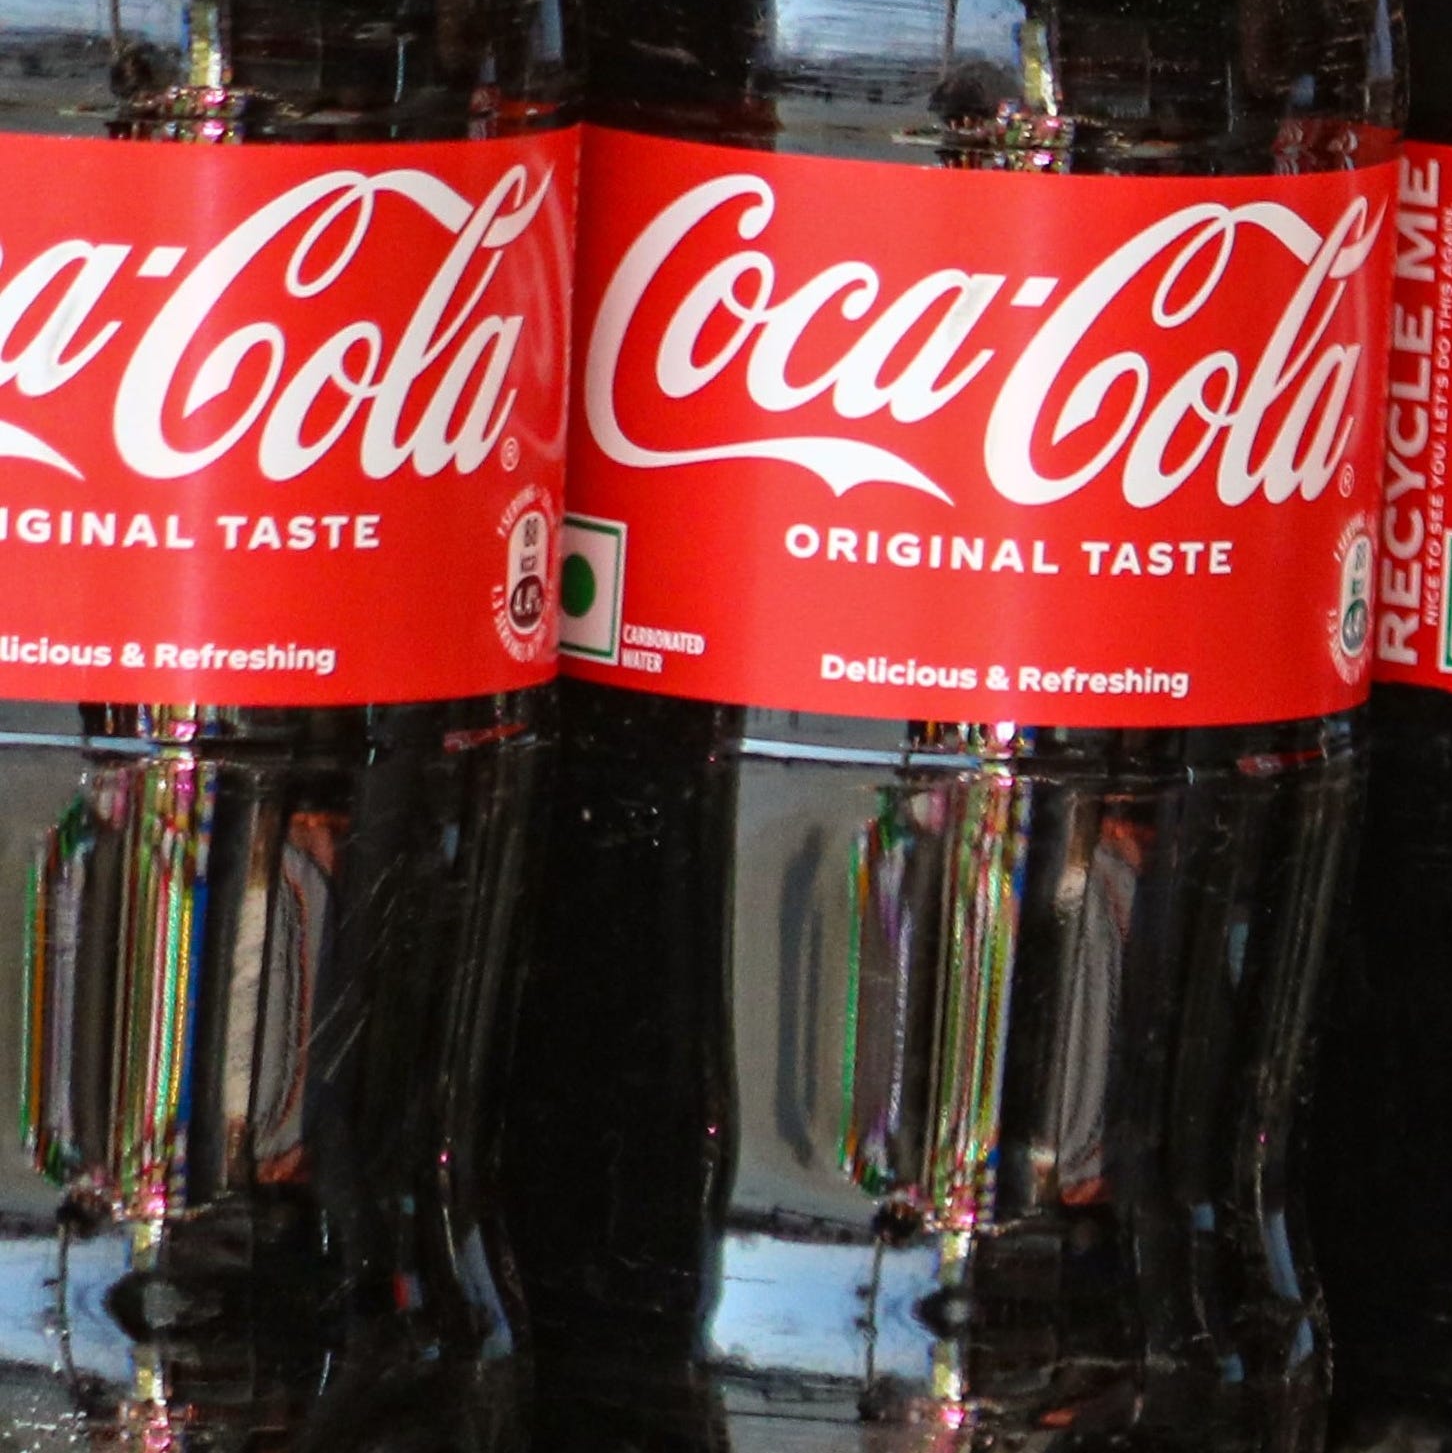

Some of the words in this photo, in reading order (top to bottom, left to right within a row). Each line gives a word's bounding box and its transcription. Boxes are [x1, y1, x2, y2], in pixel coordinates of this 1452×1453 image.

[1395, 157, 1440, 282] ME
[586, 174, 1388, 507] Coca-Cola
[1436, 338, 1451, 368] DO
[1433, 376, 1449, 434] LET'S
[1379, 304, 1433, 665] RECYCLE
[216, 515, 379, 549] TASTE
[1429, 494, 1444, 535] SEE
[785, 524, 1058, 573] ORIGINAL
[1081, 541, 1232, 575] TASTE
[1428, 540, 1442, 572] TO
[1425, 578, 1441, 626] NICE
[121, 643, 145, 667] &
[153, 642, 335, 674] Refreshing
[621, 648, 663, 673] WATER
[622, 624, 706, 656] CARBONATED
[821, 654, 977, 689] Delicious
[986, 665, 1009, 690] &
[1018, 666, 1188, 698] Refreshing
